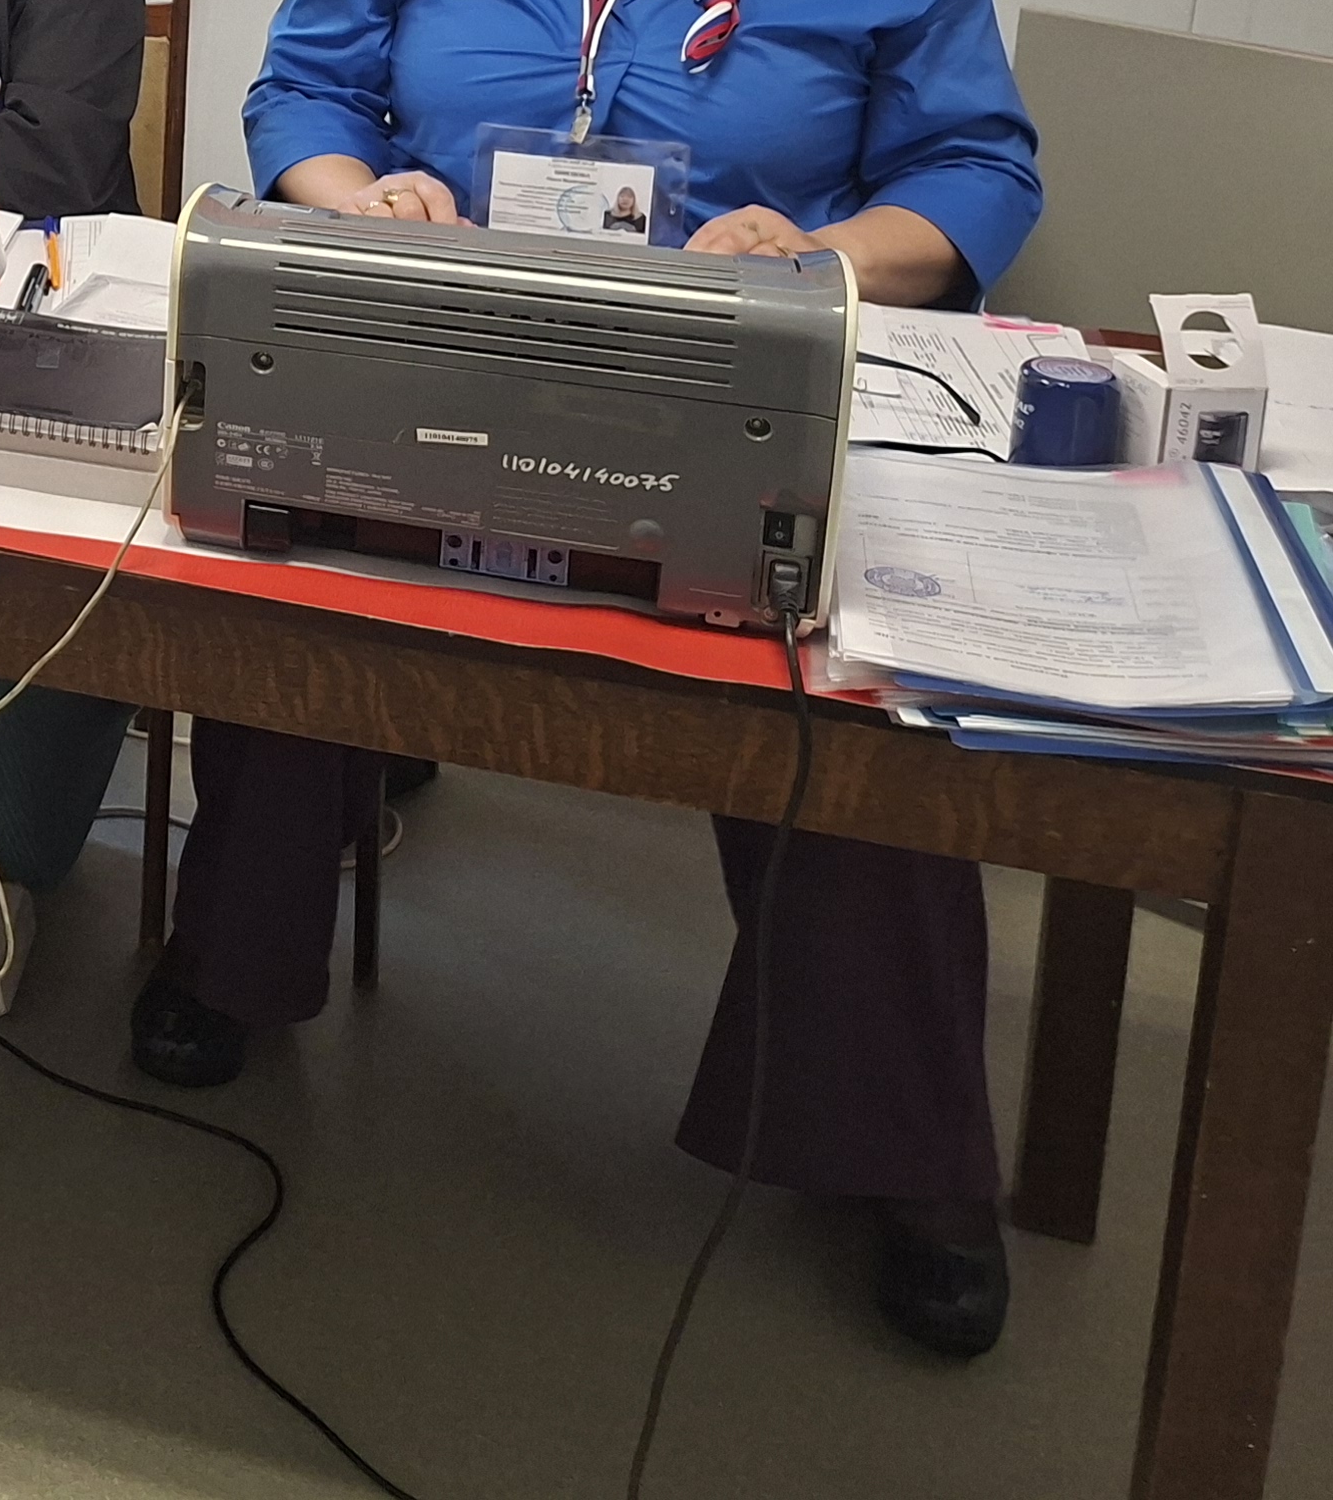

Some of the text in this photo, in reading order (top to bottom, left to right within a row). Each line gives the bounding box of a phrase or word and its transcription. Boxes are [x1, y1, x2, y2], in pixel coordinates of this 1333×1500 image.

[217, 421, 251, 433] Canon
[1176, 402, 1192, 446] 46042
[502, 454, 681, 492] 110104140075
